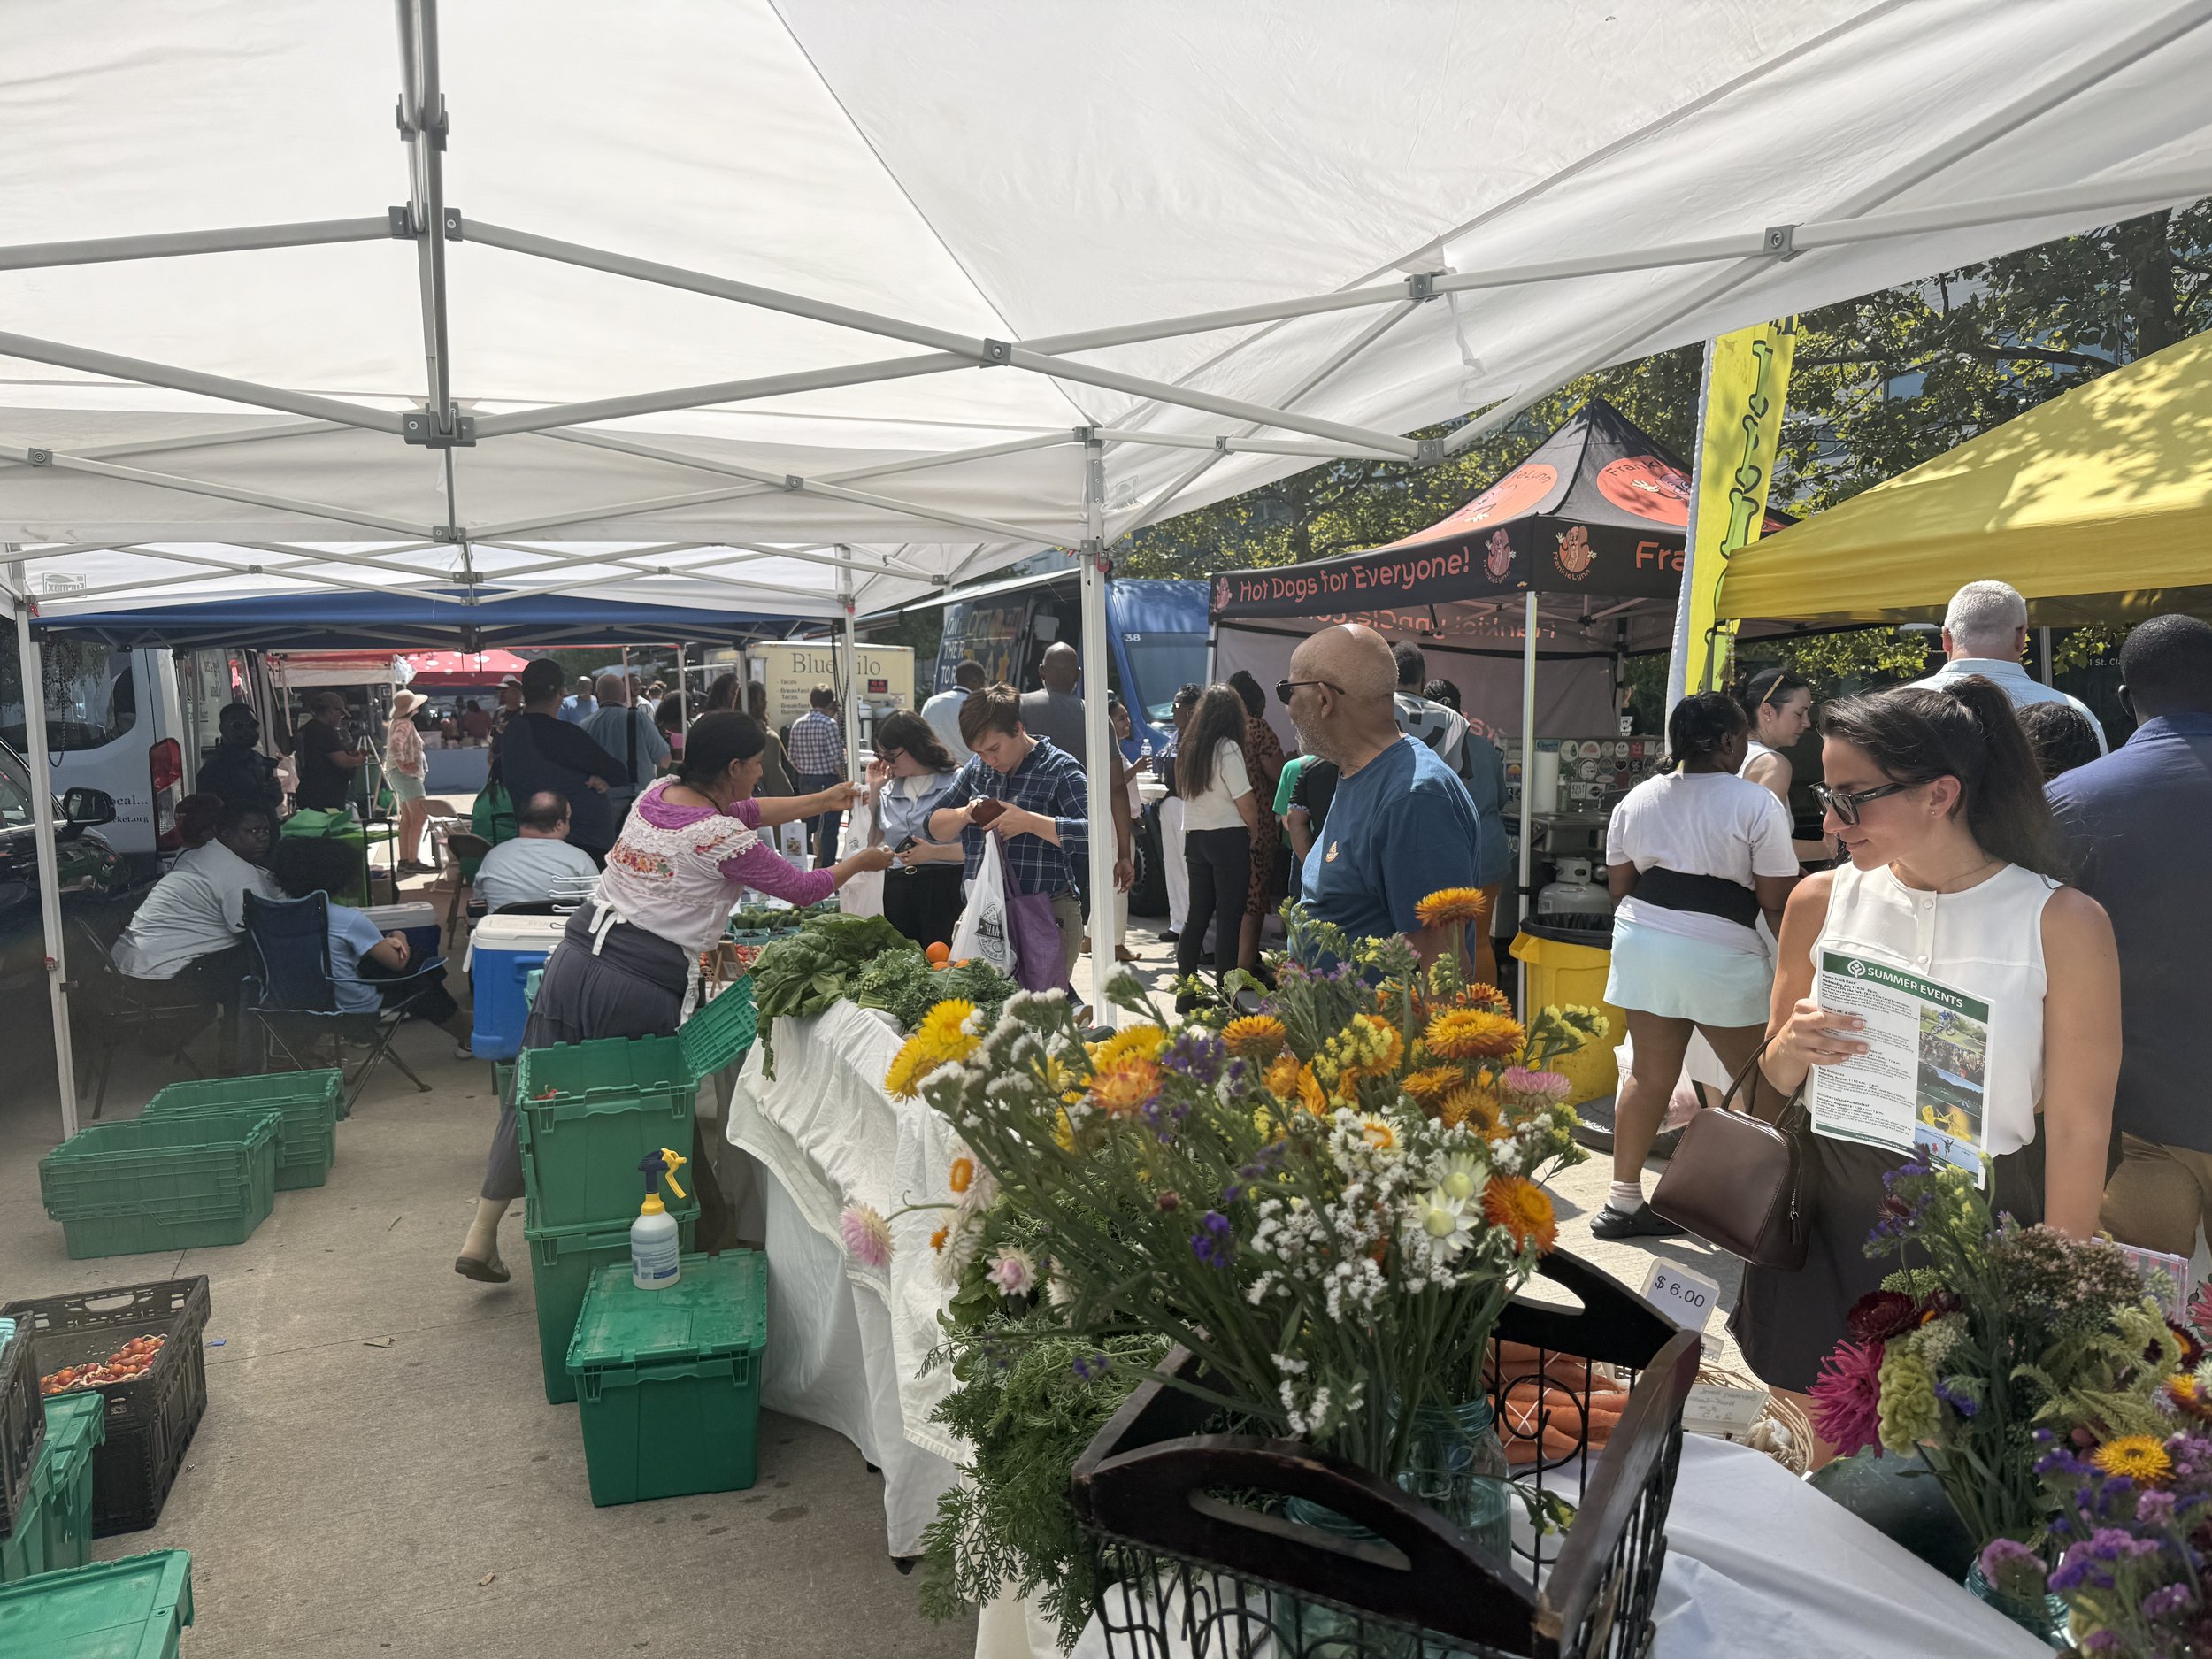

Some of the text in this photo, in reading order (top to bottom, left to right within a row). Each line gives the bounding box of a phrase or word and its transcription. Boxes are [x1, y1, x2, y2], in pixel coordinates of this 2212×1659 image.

[1552, 551, 1591, 581] FrankieLynn
[1636, 541, 1686, 572] Fra
[1240, 546, 1470, 603] Hot Dogs for Everyone!
[947, 617, 960, 635] ON
[1125, 634, 1141, 642] 38
[943, 641, 958, 659] THE
[2095, 657, 2107, 666] St.
[792, 653, 881, 676] Blue ilo
[941, 665, 950, 684] TO
[1868, 967, 1918, 991] SUMMER
[1920, 984, 1963, 1008] EVENTS
[1655, 1275, 1706, 1308] $ 6.00
